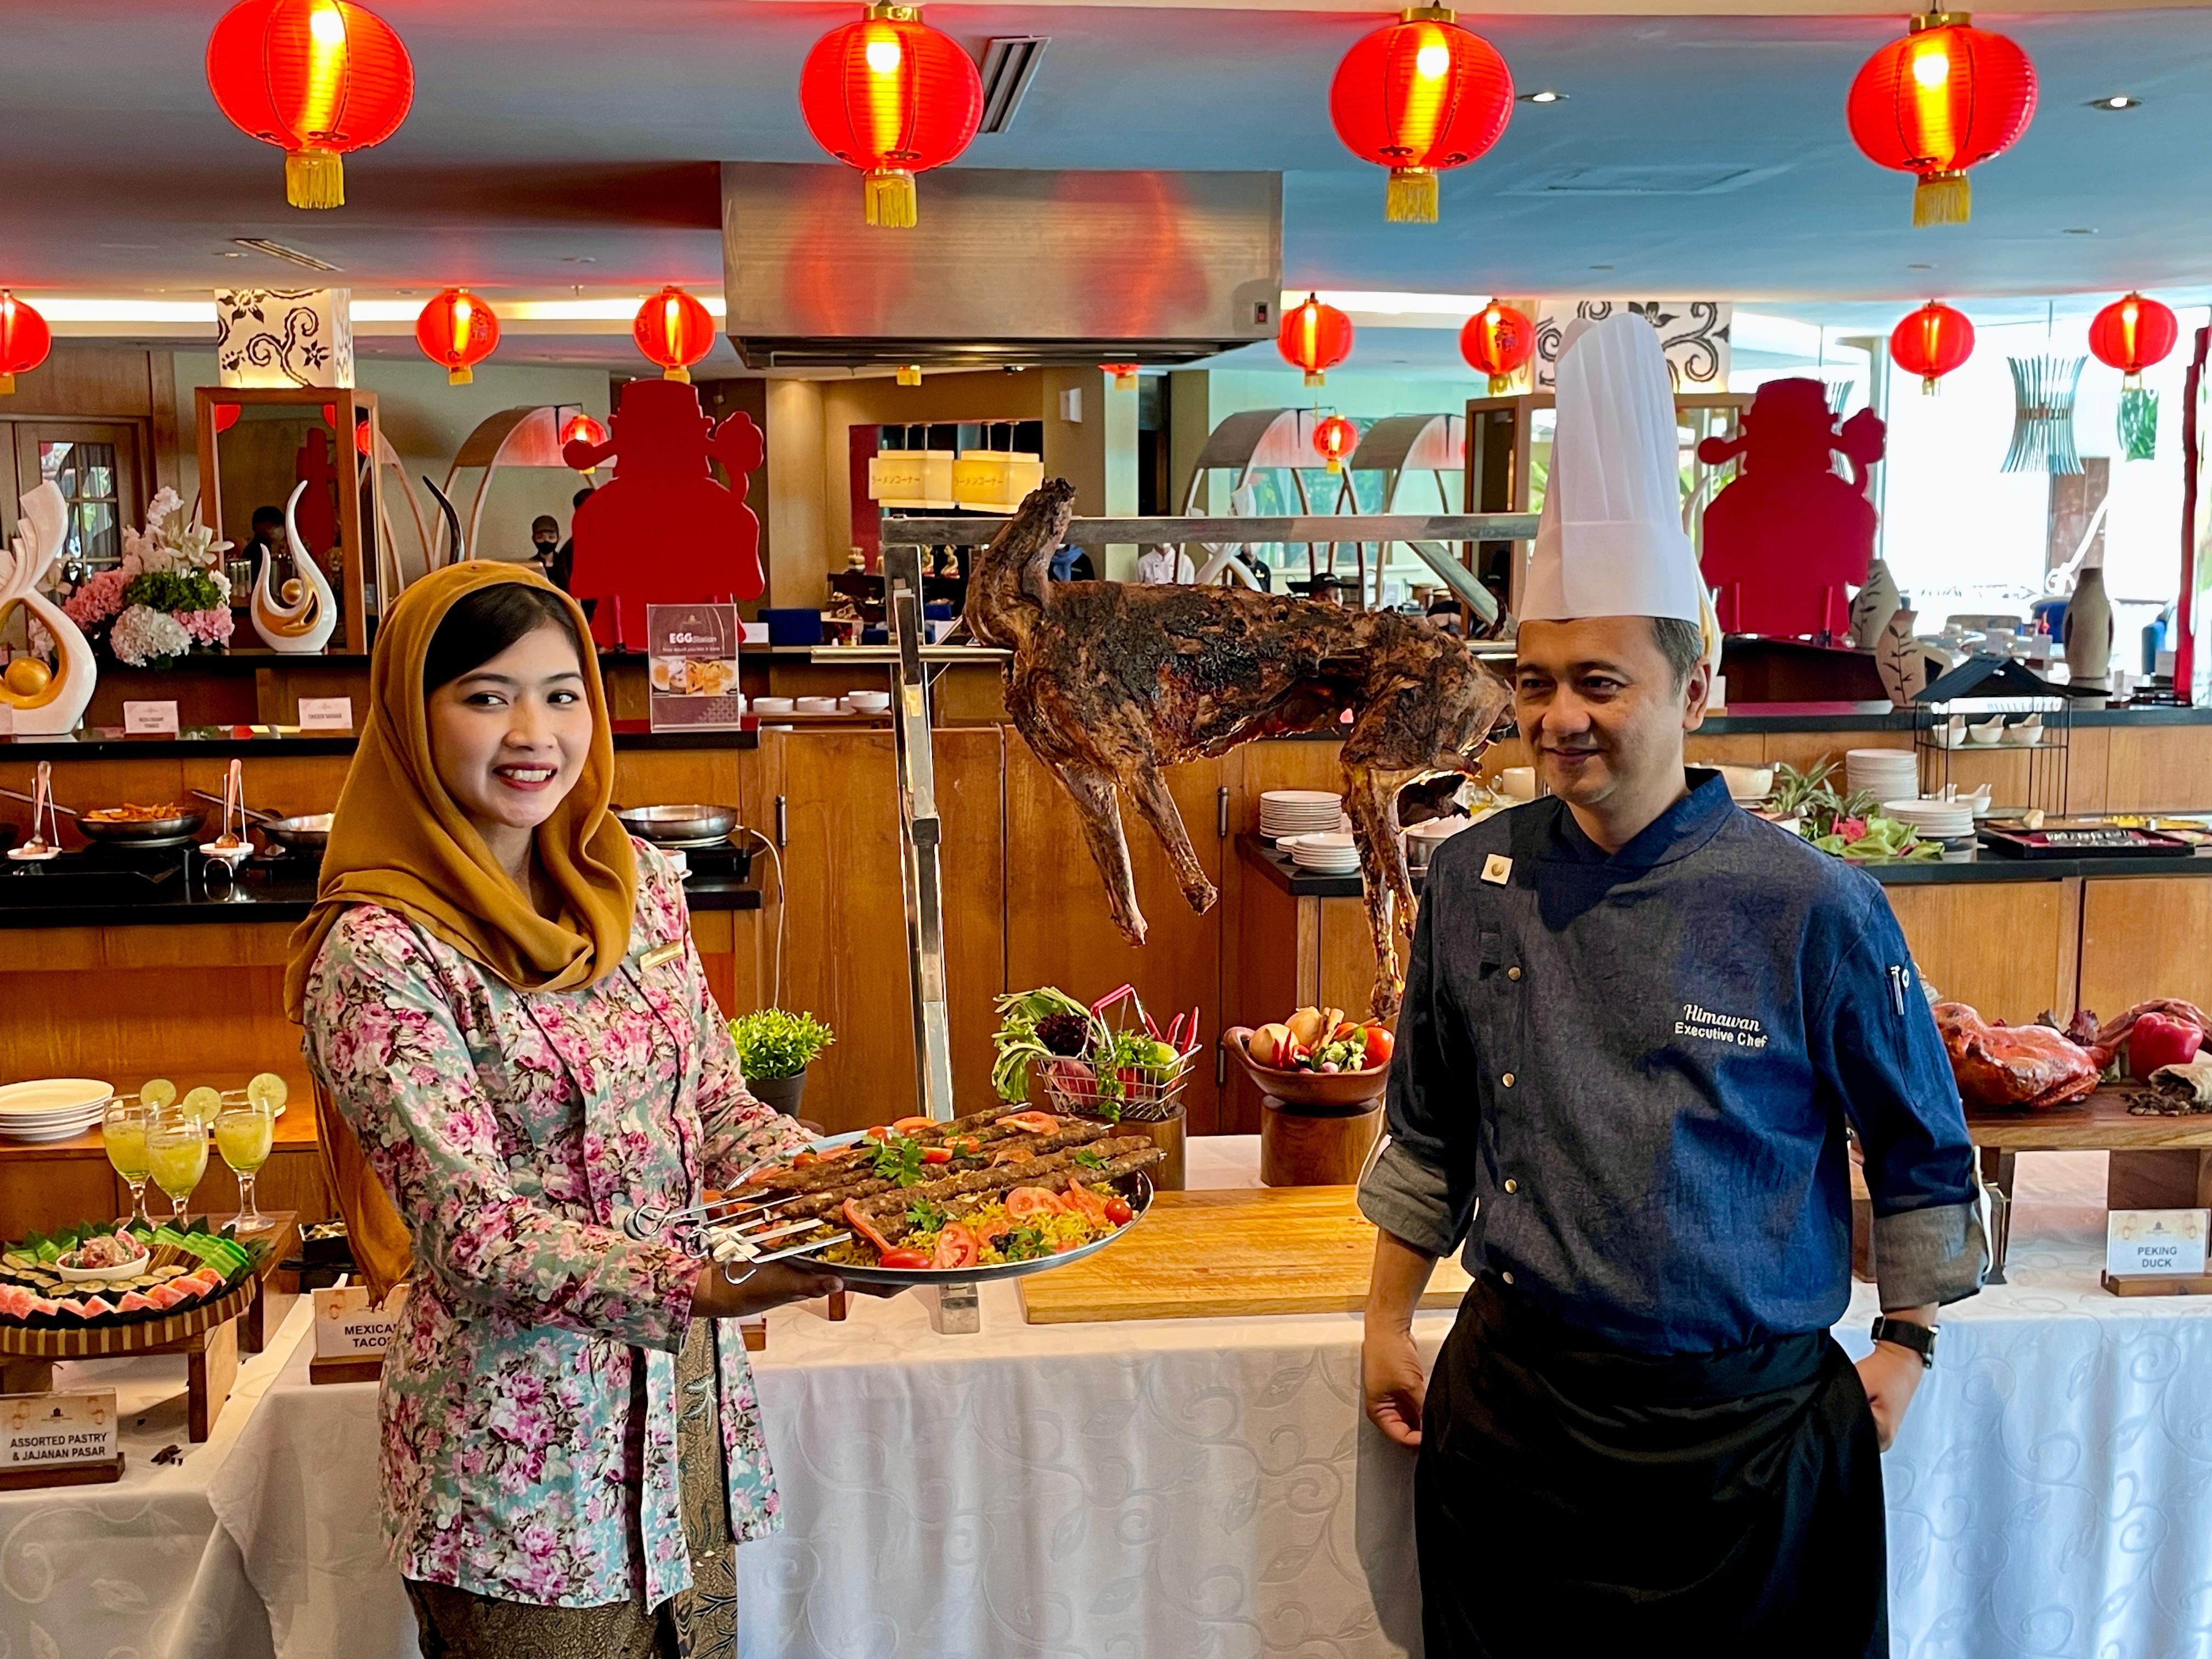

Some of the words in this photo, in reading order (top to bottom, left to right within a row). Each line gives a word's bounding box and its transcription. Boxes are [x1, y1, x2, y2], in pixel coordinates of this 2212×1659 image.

[669, 633, 692, 644] EGG
[1683, 1004, 1760, 1031] Himawan
[1675, 1022, 1734, 1042] Executive
[1737, 1032, 1768, 1047] Chef
[2137, 1246, 2177, 1255] PEKING
[2142, 1259, 2172, 1268] DUCK
[352, 1336, 390, 1347] TACO
[10, 1435, 65, 1447] ASSORTED
[68, 1432, 107, 1444] PASTRY
[13, 1452, 19, 1460] &
[22, 1448, 69, 1460] JAJANAN
[72, 1446, 105, 1457] PASAR
